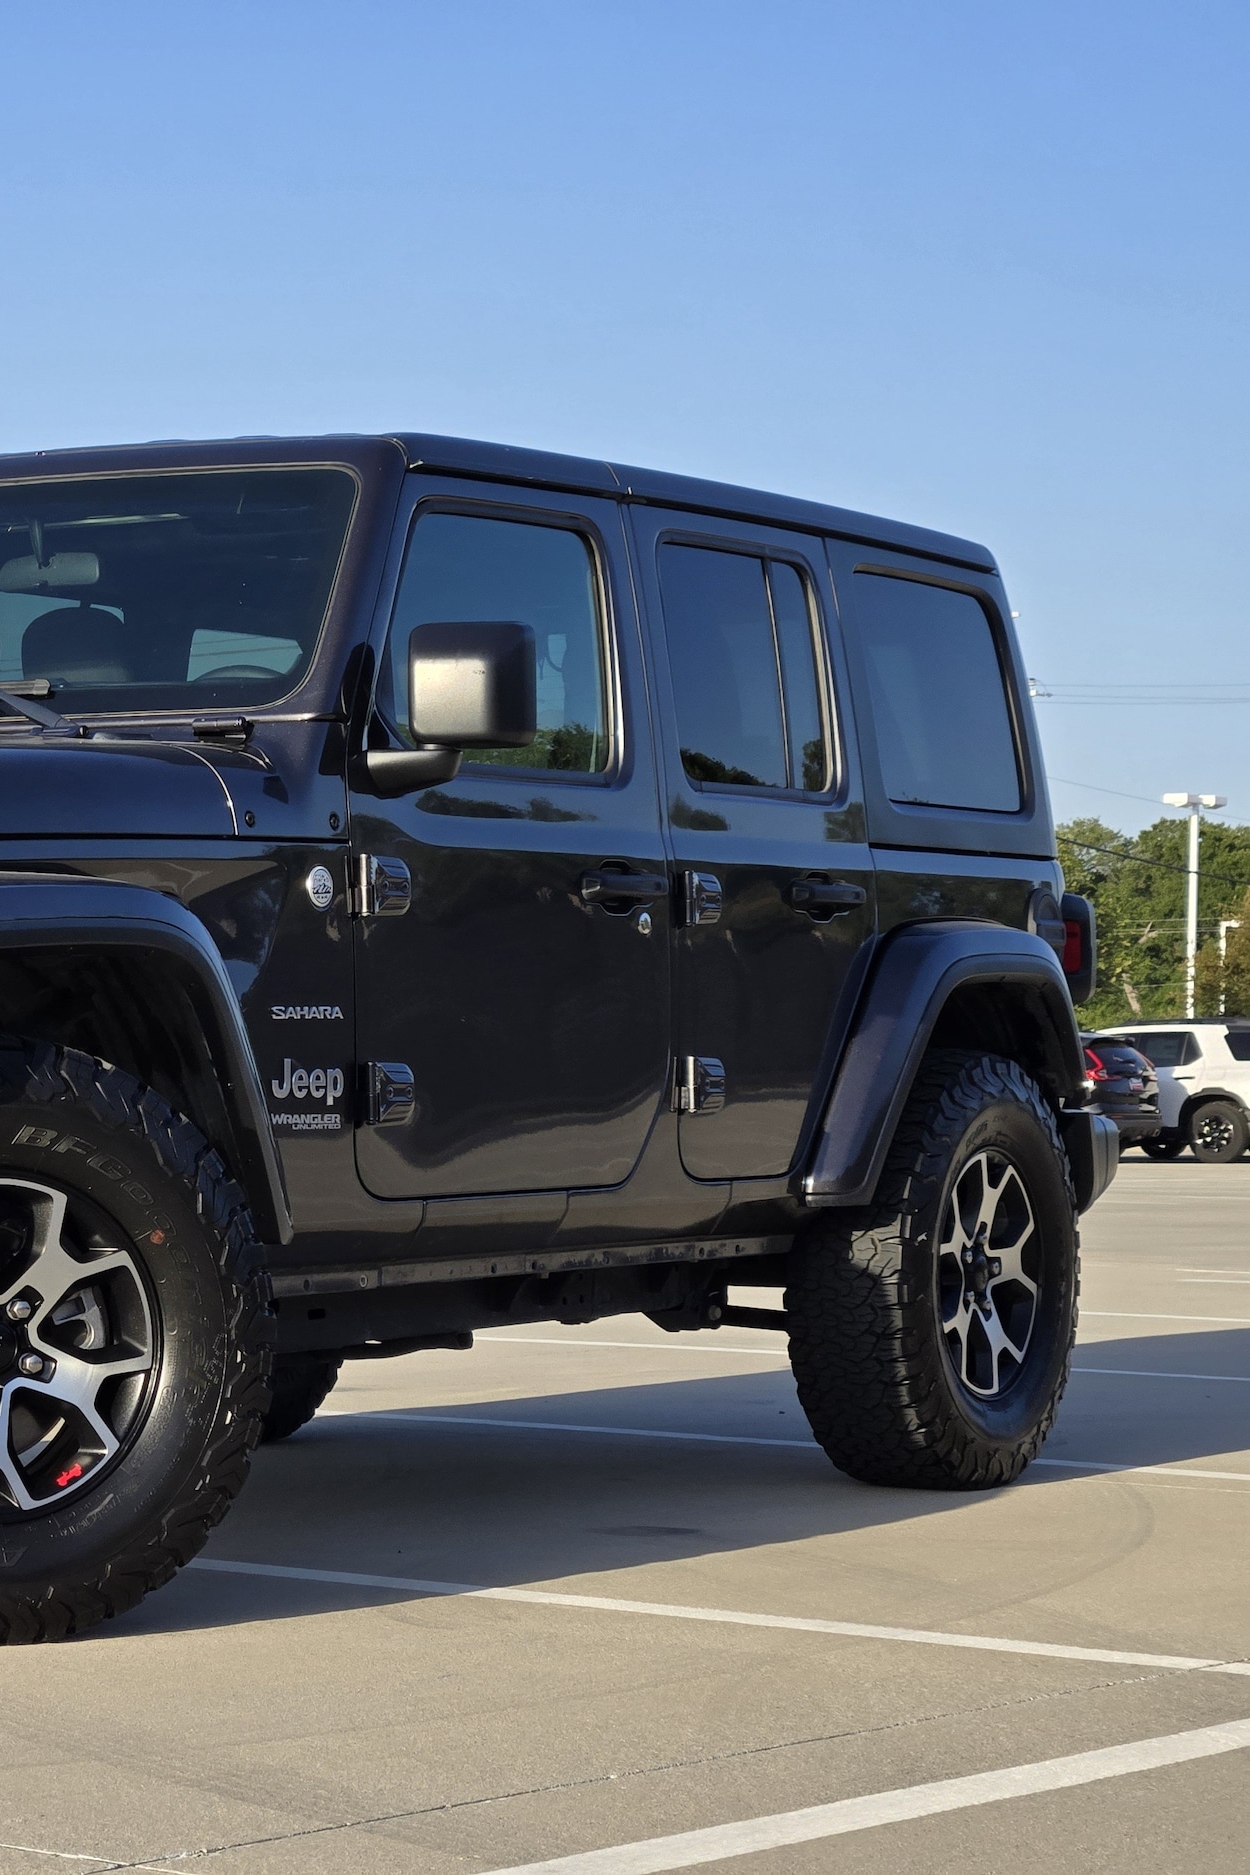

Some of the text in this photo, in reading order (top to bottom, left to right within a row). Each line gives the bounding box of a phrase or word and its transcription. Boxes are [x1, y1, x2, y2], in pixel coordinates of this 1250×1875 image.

[270, 1005, 344, 1020] SAHARA
[271, 1058, 344, 1106] Jeep
[270, 1113, 341, 1125] WRANGLER
